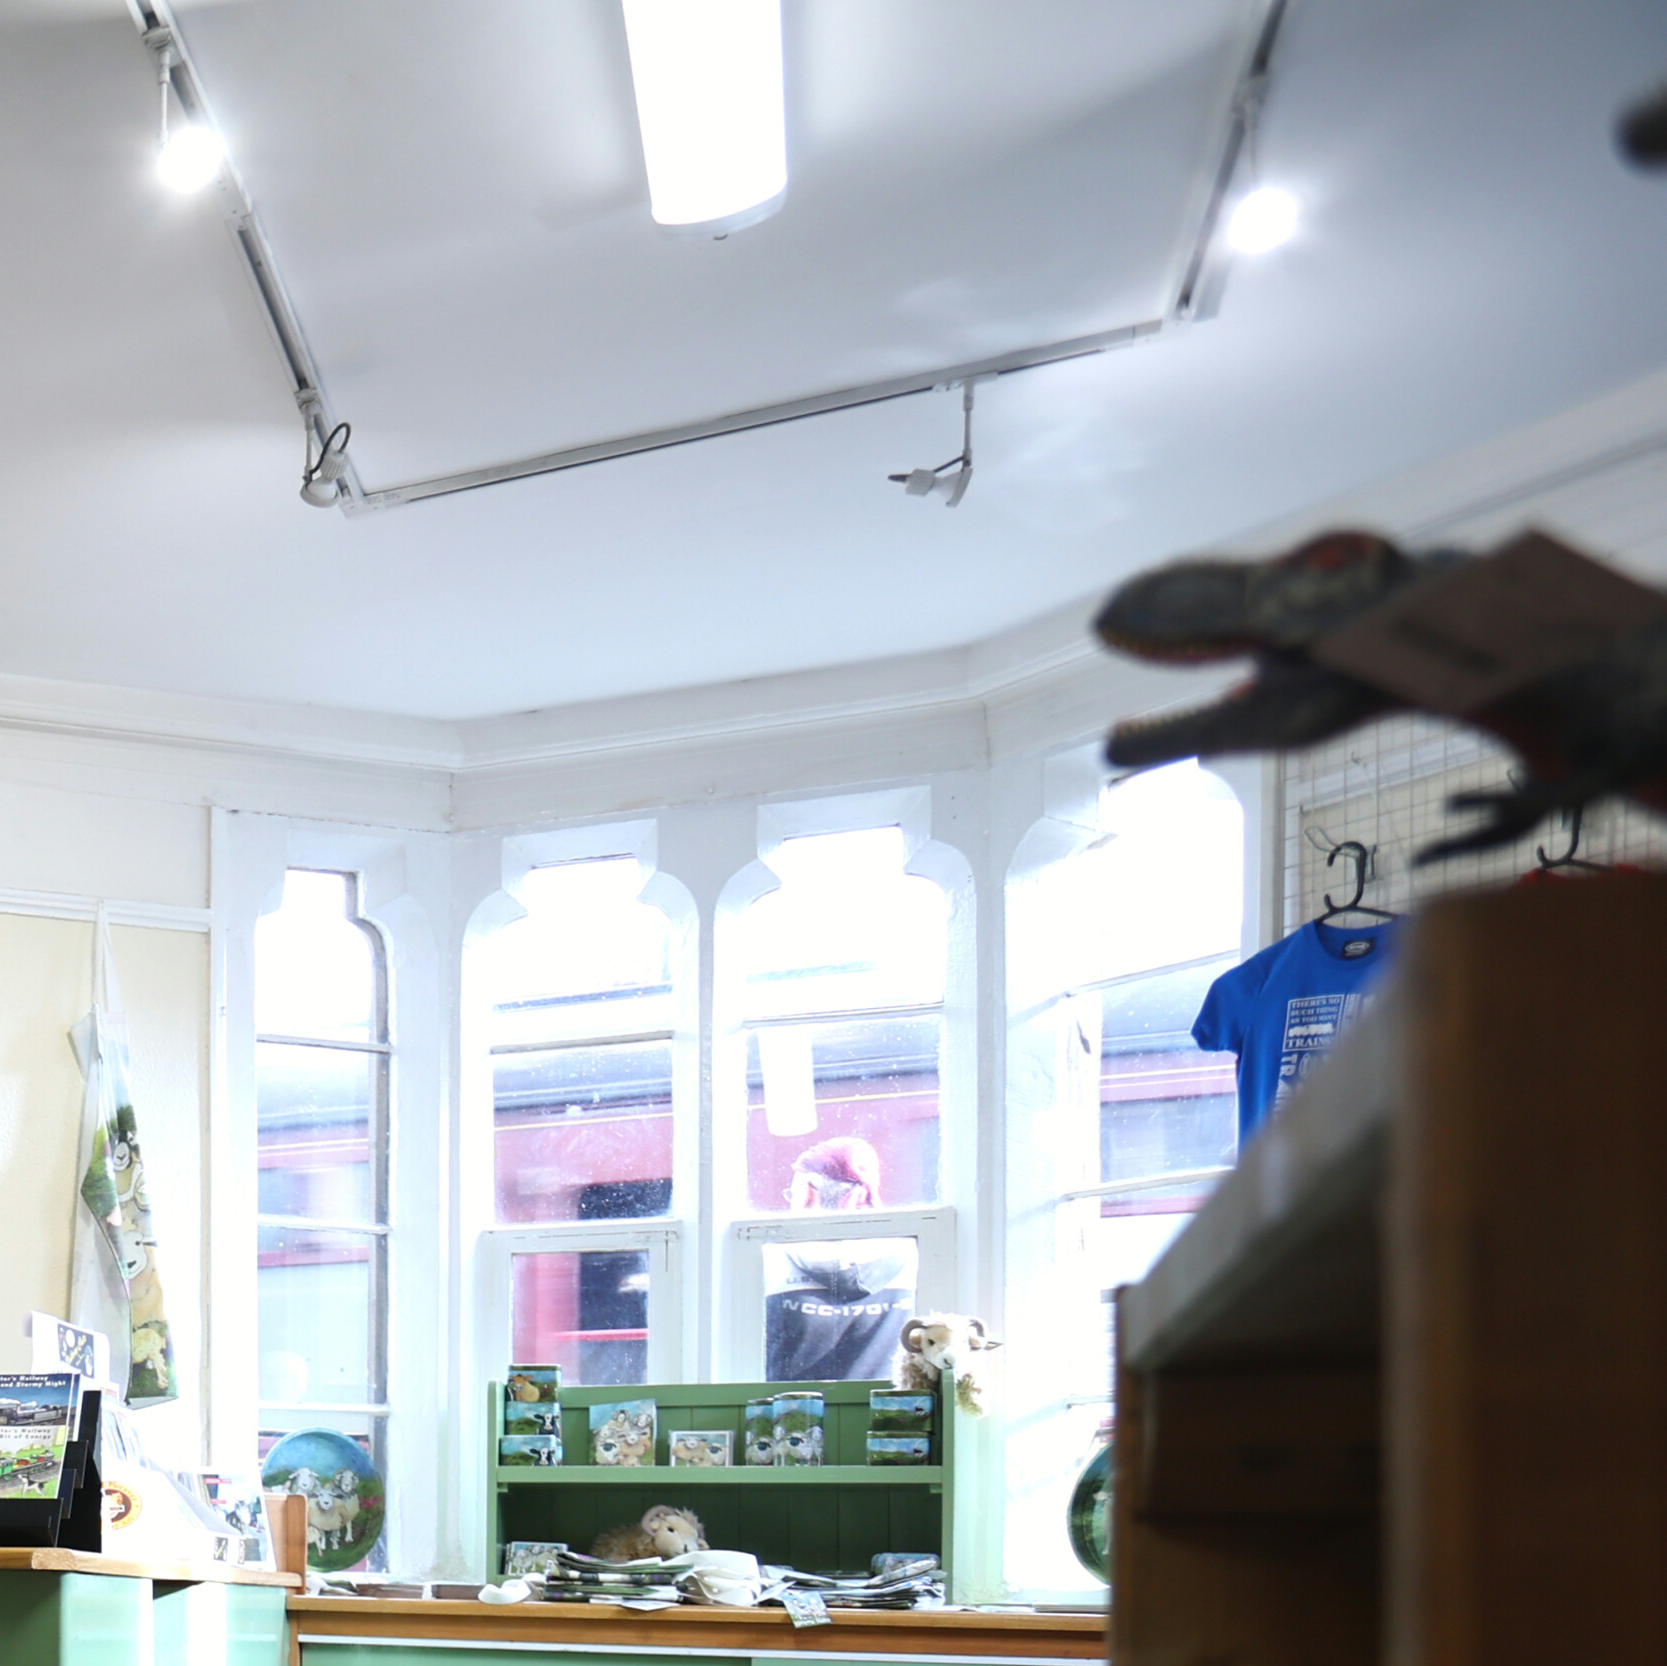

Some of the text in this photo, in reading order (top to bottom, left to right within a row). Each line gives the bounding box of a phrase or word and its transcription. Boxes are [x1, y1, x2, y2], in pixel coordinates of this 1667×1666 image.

[1291, 1006, 1338, 1016] SUCH THING
[45, 1380, 66, 1388] Night
[21, 1427, 51, 1435] Railway
